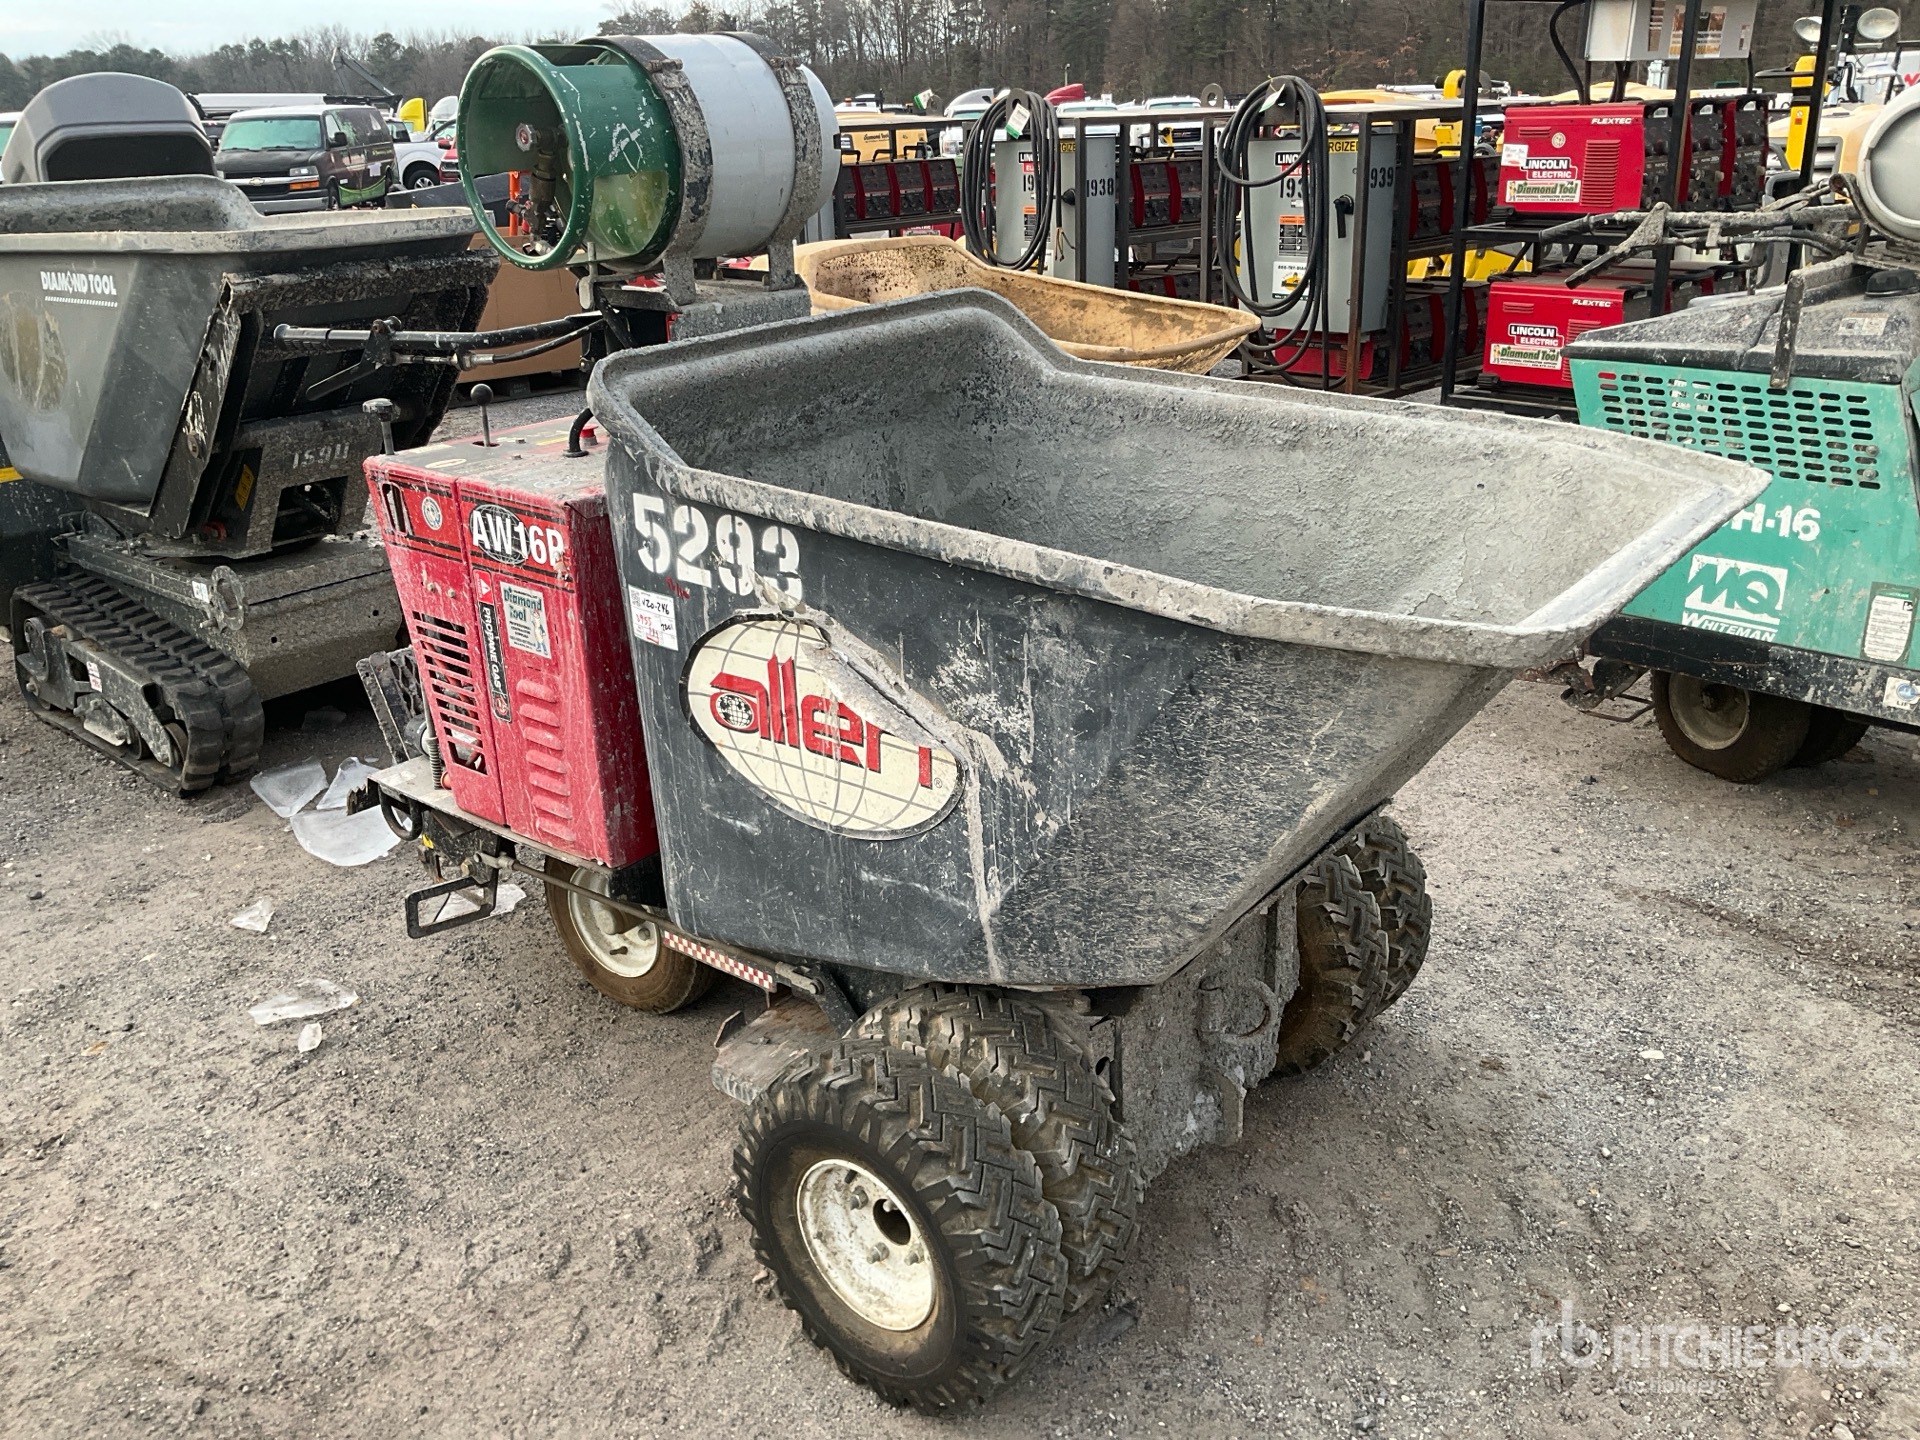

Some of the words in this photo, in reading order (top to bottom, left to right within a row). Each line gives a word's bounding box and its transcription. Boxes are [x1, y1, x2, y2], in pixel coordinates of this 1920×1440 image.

[1523, 159, 1568, 169] LINCOLN
[1532, 170, 1572, 178] ELECTRIC
[1516, 182, 1558, 194] Diamond
[1558, 183, 1578, 194] Tool
[40, 271, 88, 294] DIAMOND
[88, 274, 117, 295] TOOL
[1572, 299, 1611, 307] FLEXTEC
[1510, 325, 1555, 337] LINCOLN
[1520, 338, 1558, 346] ELECTRIC
[1500, 346, 1540, 360] Diamond
[1541, 350, 1560, 361] Tool
[1722, 502, 1821, 542] H-16
[632, 492, 803, 606] 5293
[504, 586, 542, 610] Diamond
[1682, 610, 1776, 642] WHITEMAN
[482, 606, 498, 662] PROPANE
[491, 664, 502, 690] GAS
